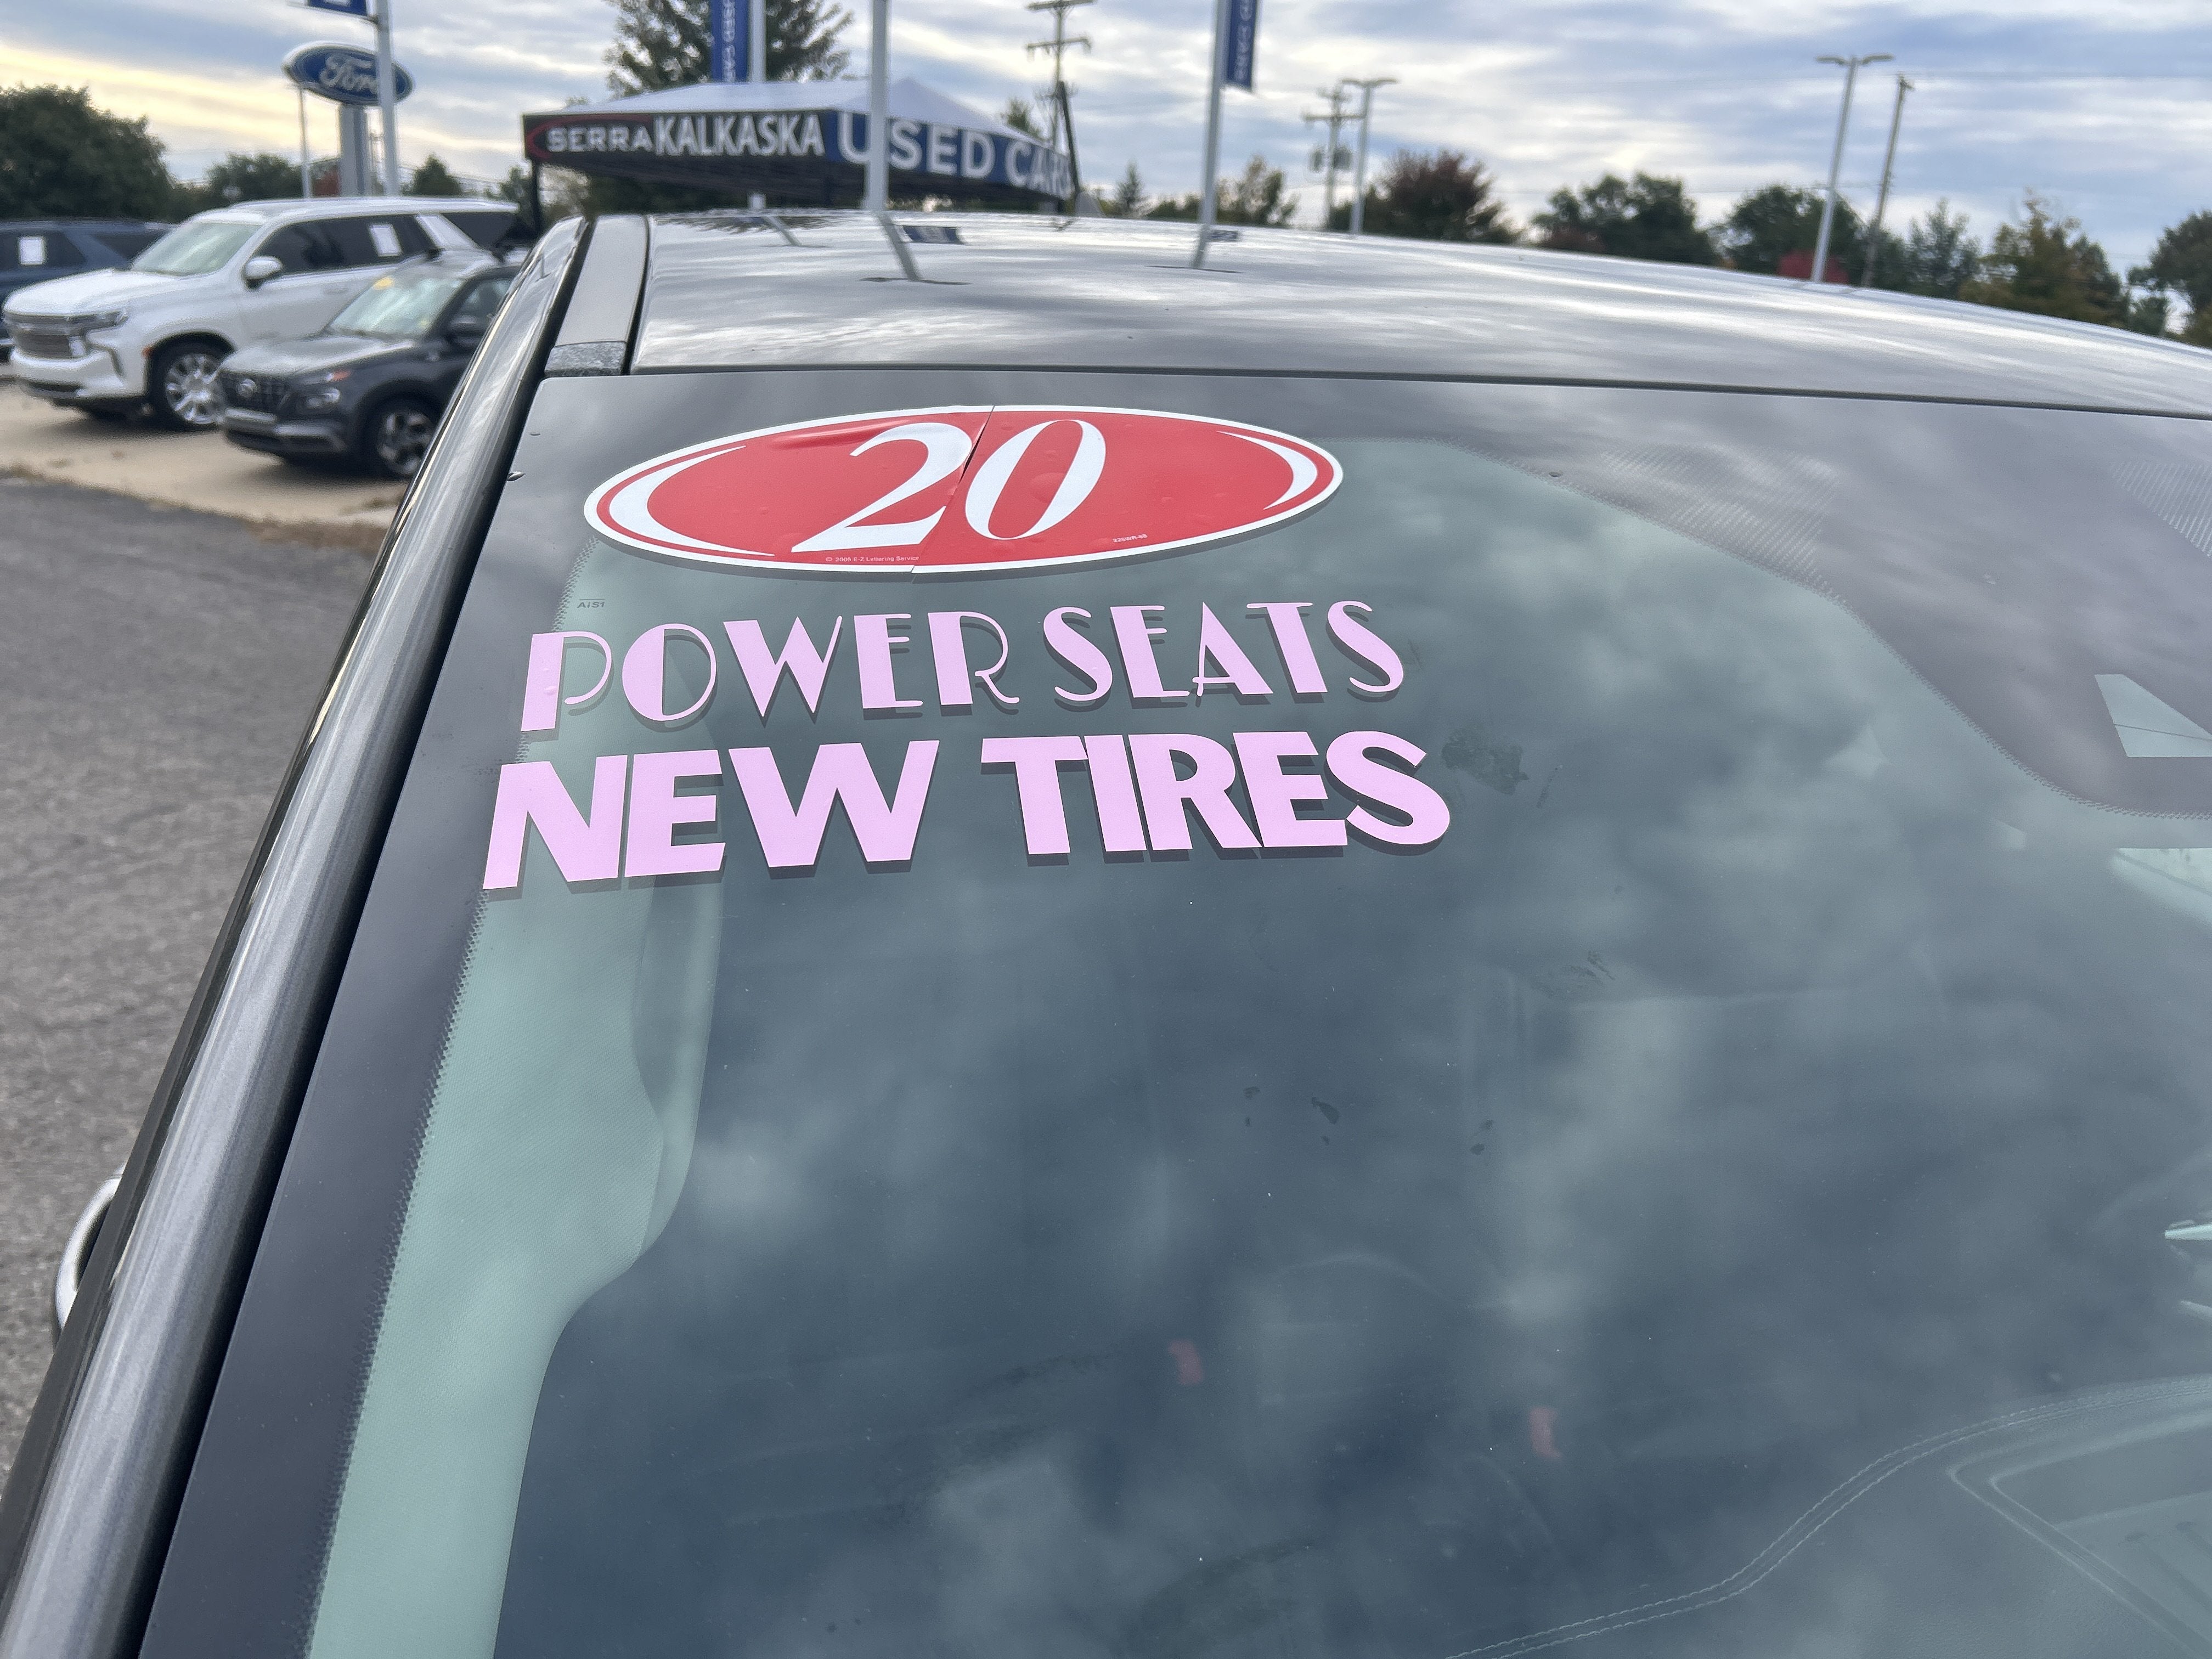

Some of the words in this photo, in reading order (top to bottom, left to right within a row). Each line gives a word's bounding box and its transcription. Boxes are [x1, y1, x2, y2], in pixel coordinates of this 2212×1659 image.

[319, 54, 379, 95] For
[548, 125, 653, 153] SERRA
[653, 112, 825, 157] KALKASKA
[837, 110, 996, 180] USED
[791, 419, 1107, 553] 20
[520, 611, 1020, 732] POWER
[1043, 600, 1404, 702] SEATS
[483, 740, 939, 890] NEW
[981, 731, 1450, 856] TIRES
